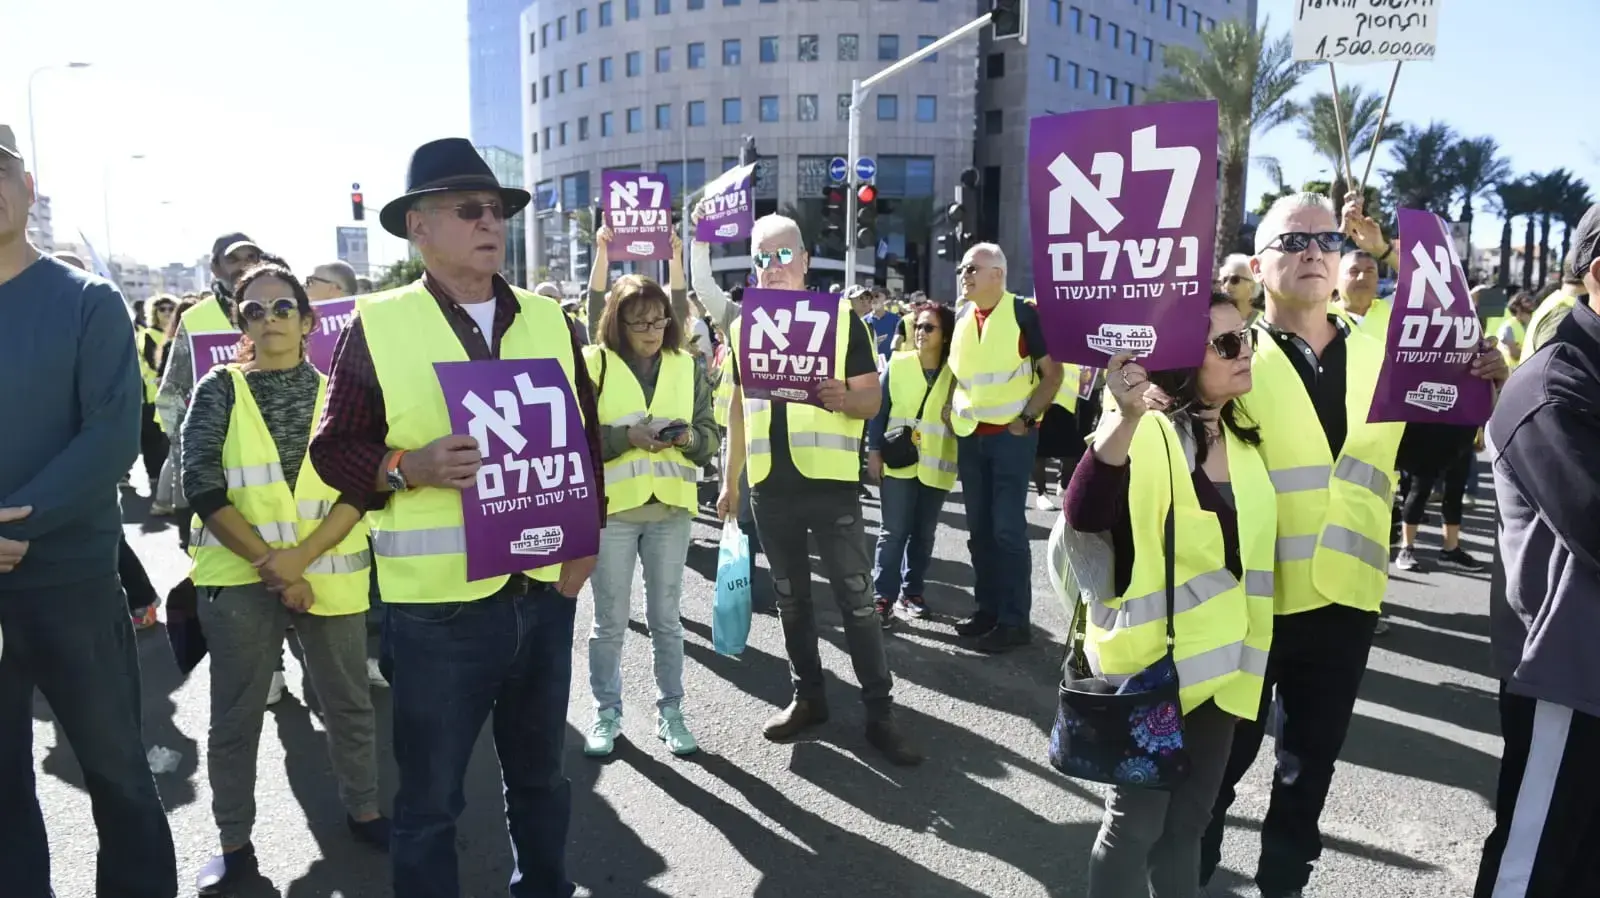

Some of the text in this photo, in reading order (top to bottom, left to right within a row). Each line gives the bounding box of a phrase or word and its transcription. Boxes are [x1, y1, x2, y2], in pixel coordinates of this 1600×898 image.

[1355, 13, 1427, 37] ותחסוך
[609, 176, 664, 208] לא
[1047, 125, 1201, 234] לא
[704, 190, 746, 215] נשלם
[611, 207, 667, 226] נשלם
[1047, 231, 1199, 281] נשלם
[1054, 281, 1199, 300] כדי שהם יתעשרו
[749, 300, 831, 352] לא
[1089, 337, 1153, 347] עומדים ביחד
[748, 349, 828, 375] נשלם
[1396, 351, 1442, 363] יתעשרו
[1444, 352, 1473, 364] שהם
[461, 372, 567, 458] לא
[476, 452, 585, 500] נשלם
[481, 486, 588, 516] כדי שהם יתעשרו
